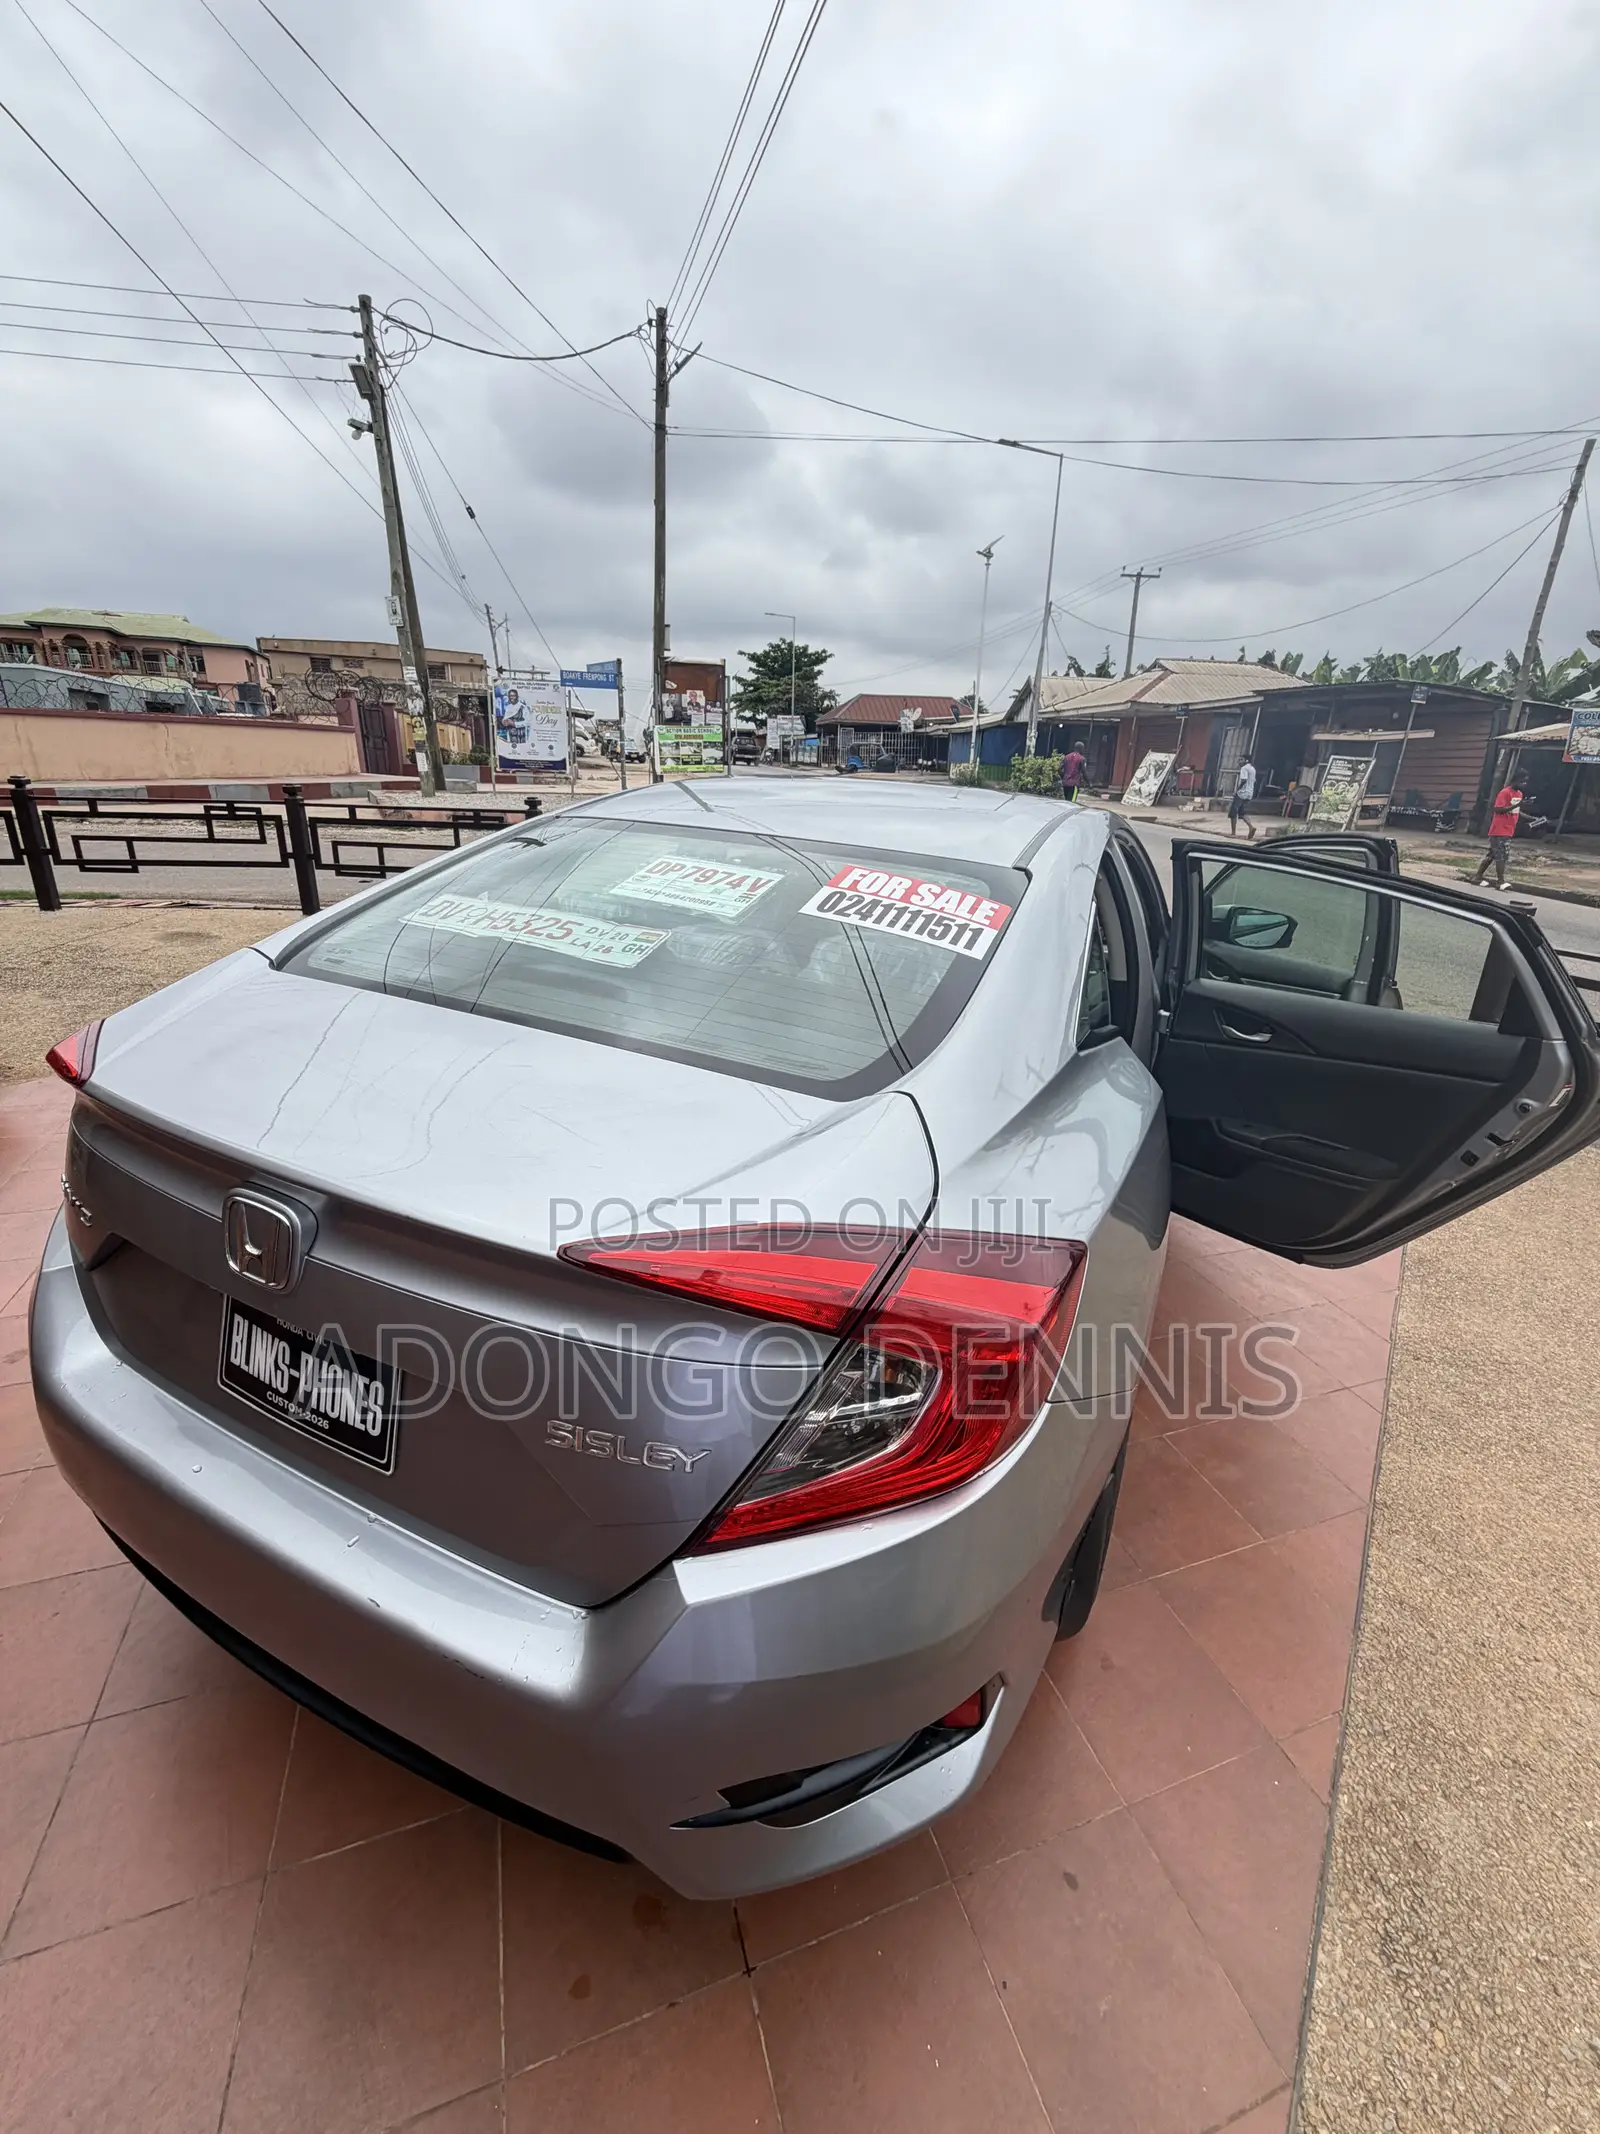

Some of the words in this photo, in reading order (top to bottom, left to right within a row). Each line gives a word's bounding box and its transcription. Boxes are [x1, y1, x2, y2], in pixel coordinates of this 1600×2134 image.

[563, 671, 582, 680] BOAKYE
[816, 890, 985, 951] 0241111511
[837, 867, 913, 900] FOR
[910, 883, 999, 925] SALE
[621, 943, 650, 955] GH
[230, 1313, 385, 1437] BLINKS-PHONES
[266, 1390, 330, 1430] CUSTOM-2026
[545, 1419, 713, 1473] SISLEY
